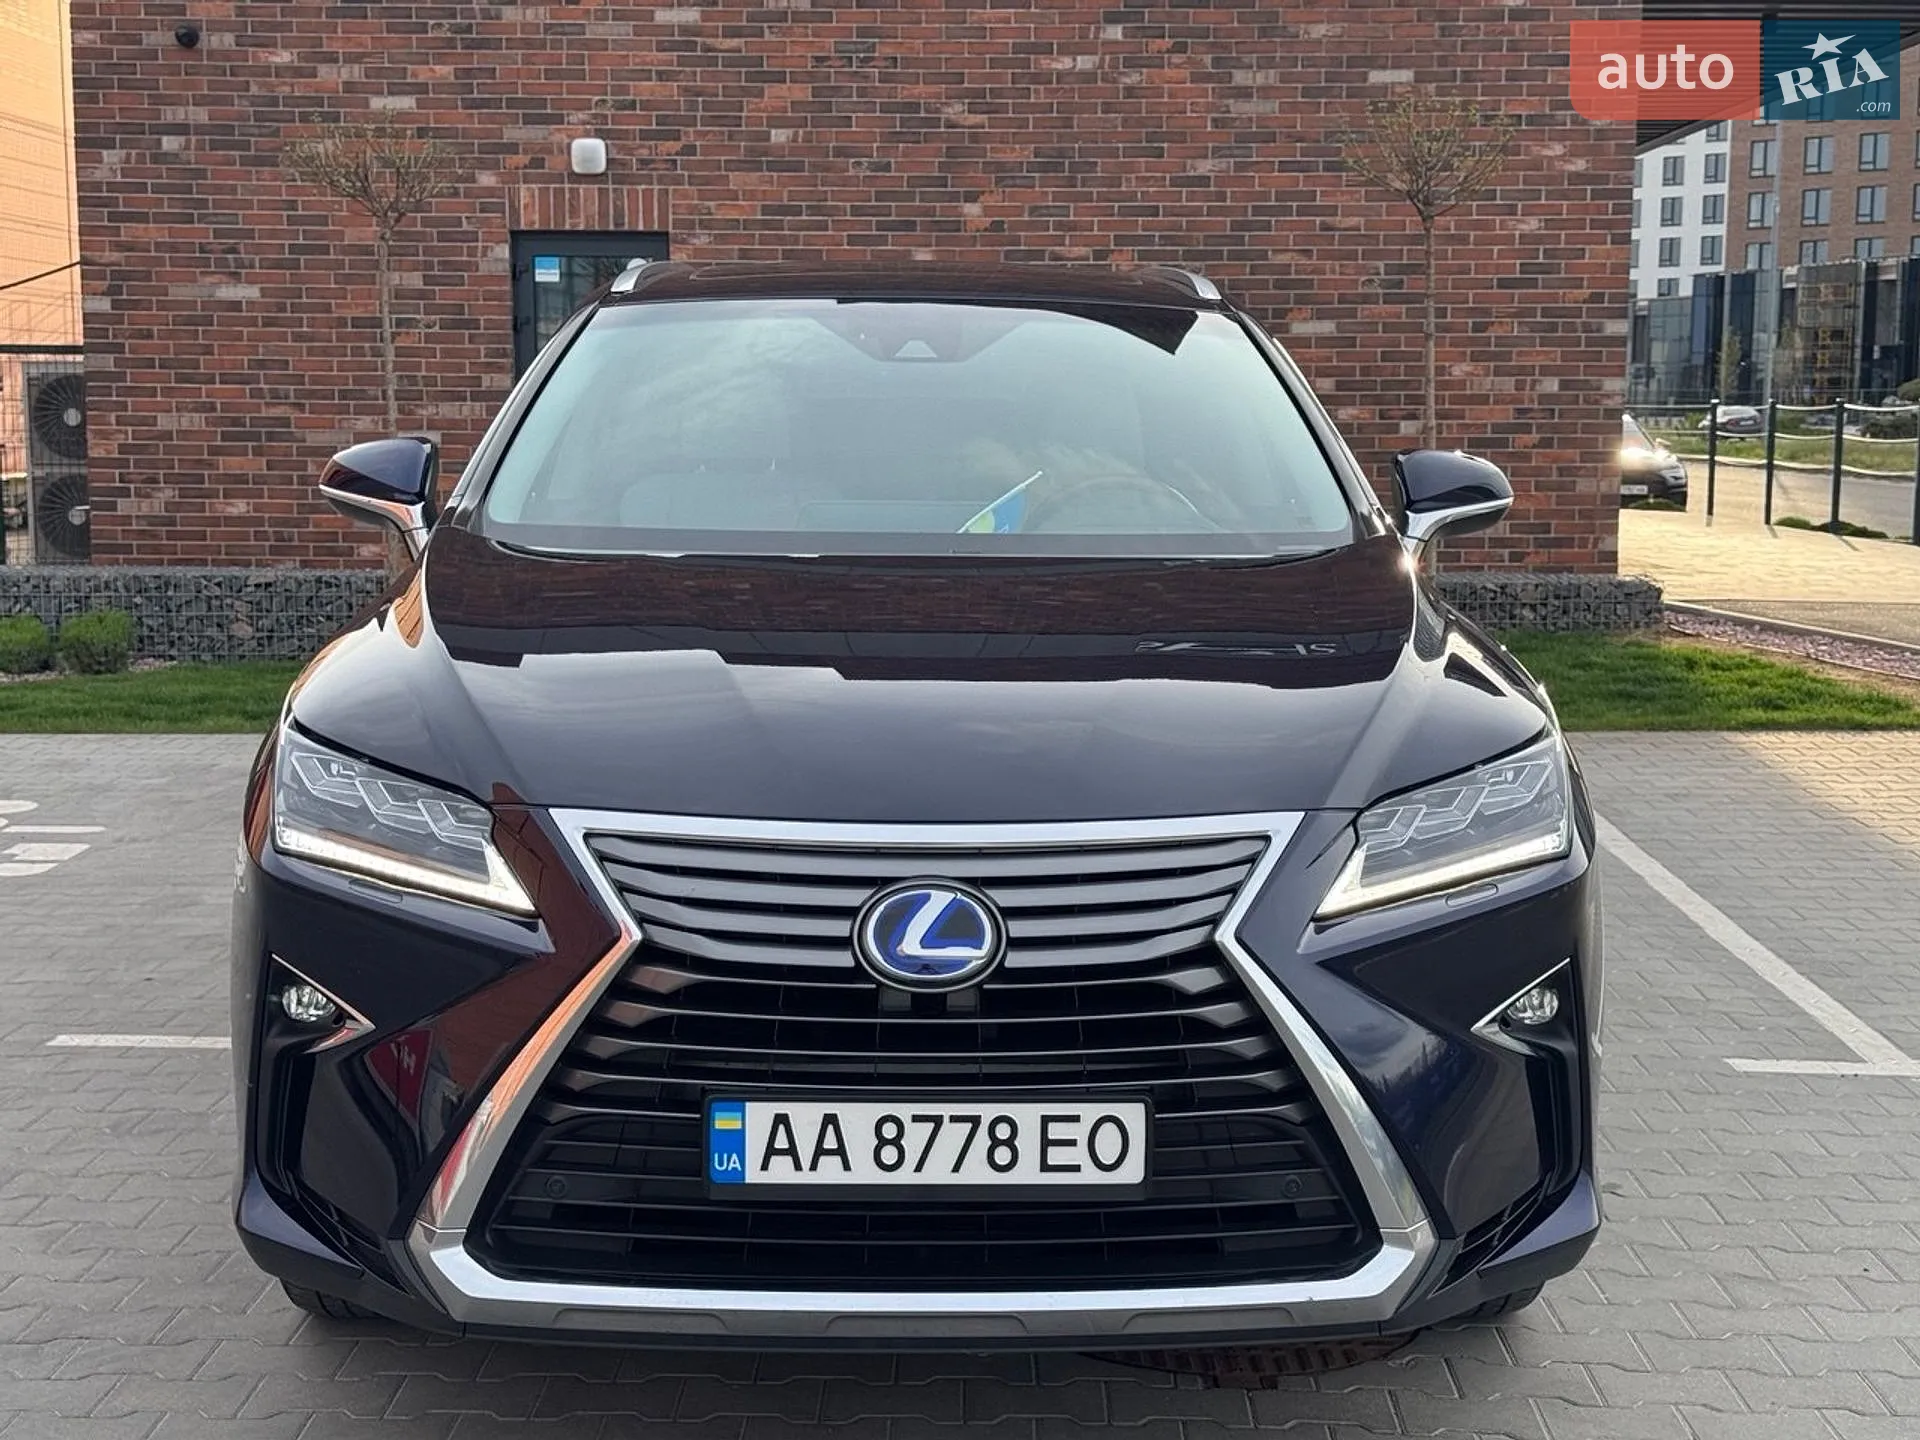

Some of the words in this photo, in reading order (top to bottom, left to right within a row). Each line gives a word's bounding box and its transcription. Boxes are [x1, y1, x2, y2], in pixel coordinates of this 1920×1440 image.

[760, 1112, 852, 1172] AA
[873, 1113, 1019, 1173] 8778
[1040, 1113, 1130, 1173] EO
[714, 1154, 742, 1172] UA
